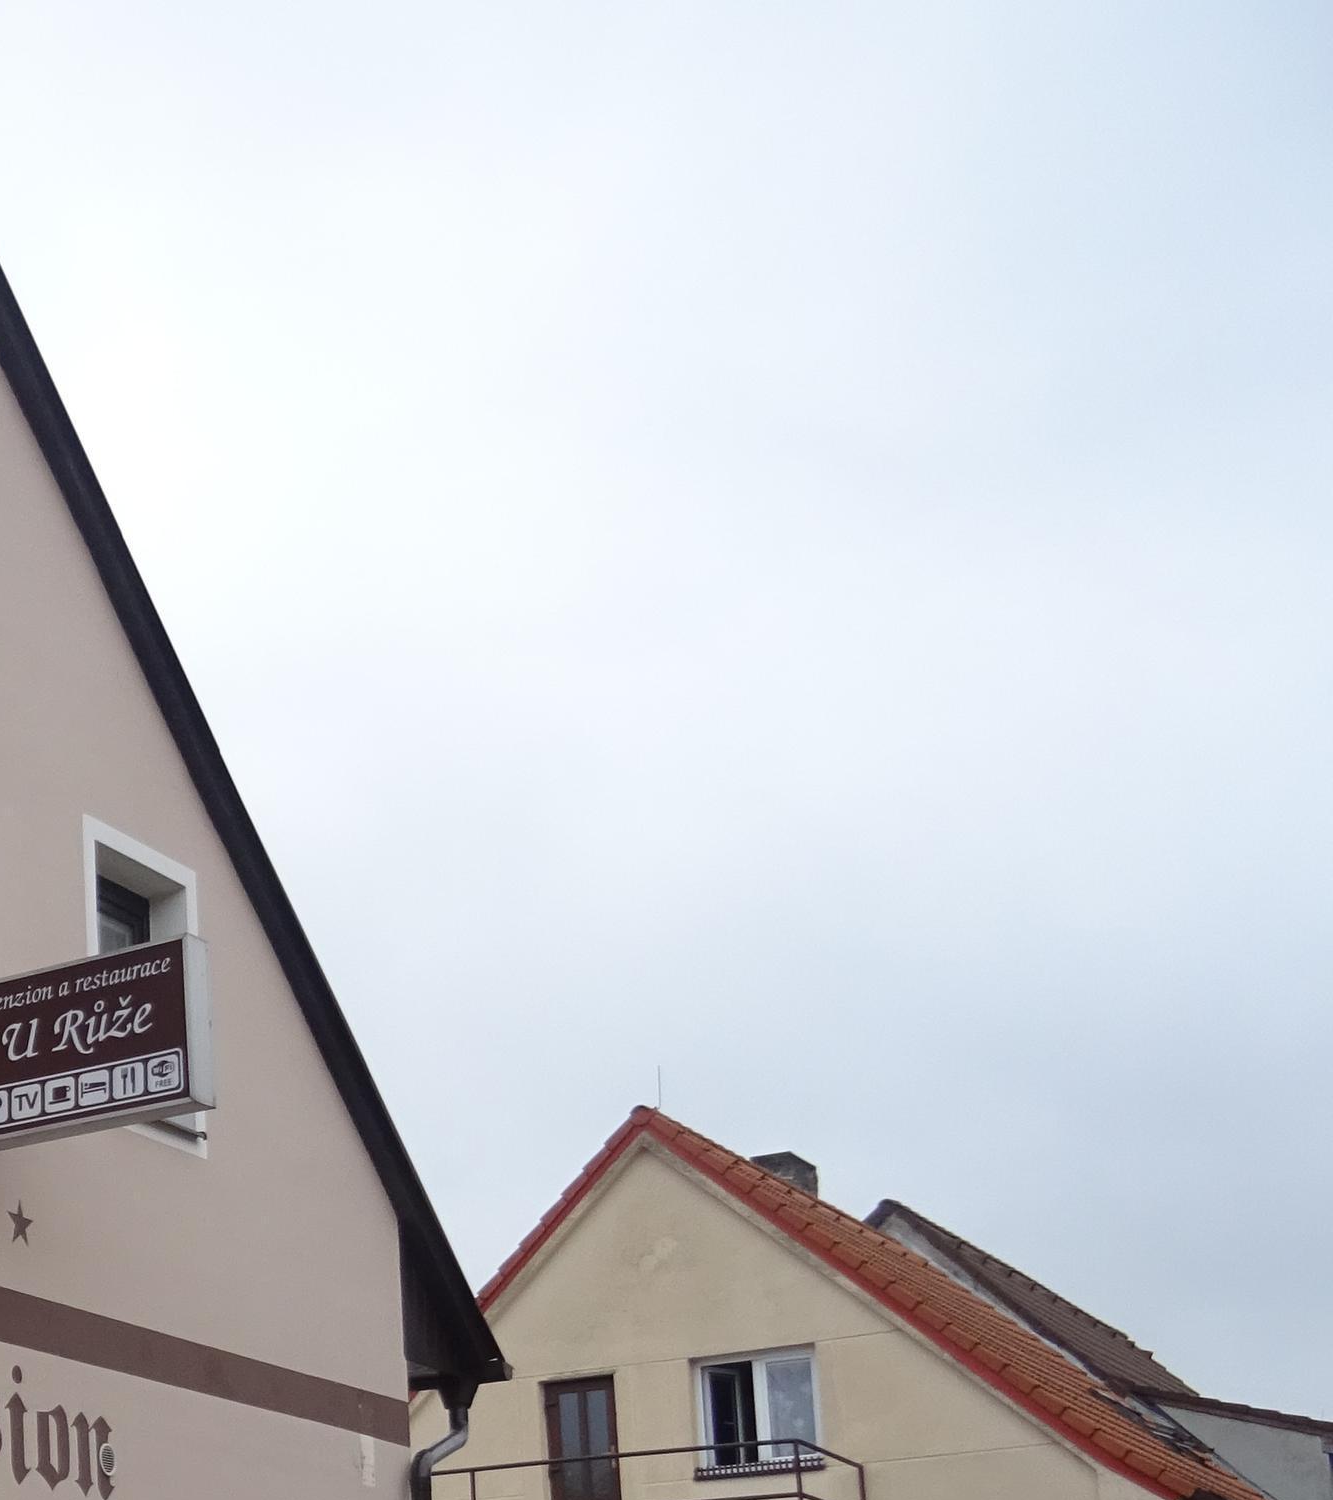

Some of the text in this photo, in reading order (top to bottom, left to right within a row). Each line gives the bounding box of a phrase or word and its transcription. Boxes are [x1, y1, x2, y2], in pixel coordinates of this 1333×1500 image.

[58, 983, 70, 998] a
[75, 956, 171, 993] restaurace
[1, 994, 154, 1062] U Růže
[14, 1090, 39, 1112] TV
